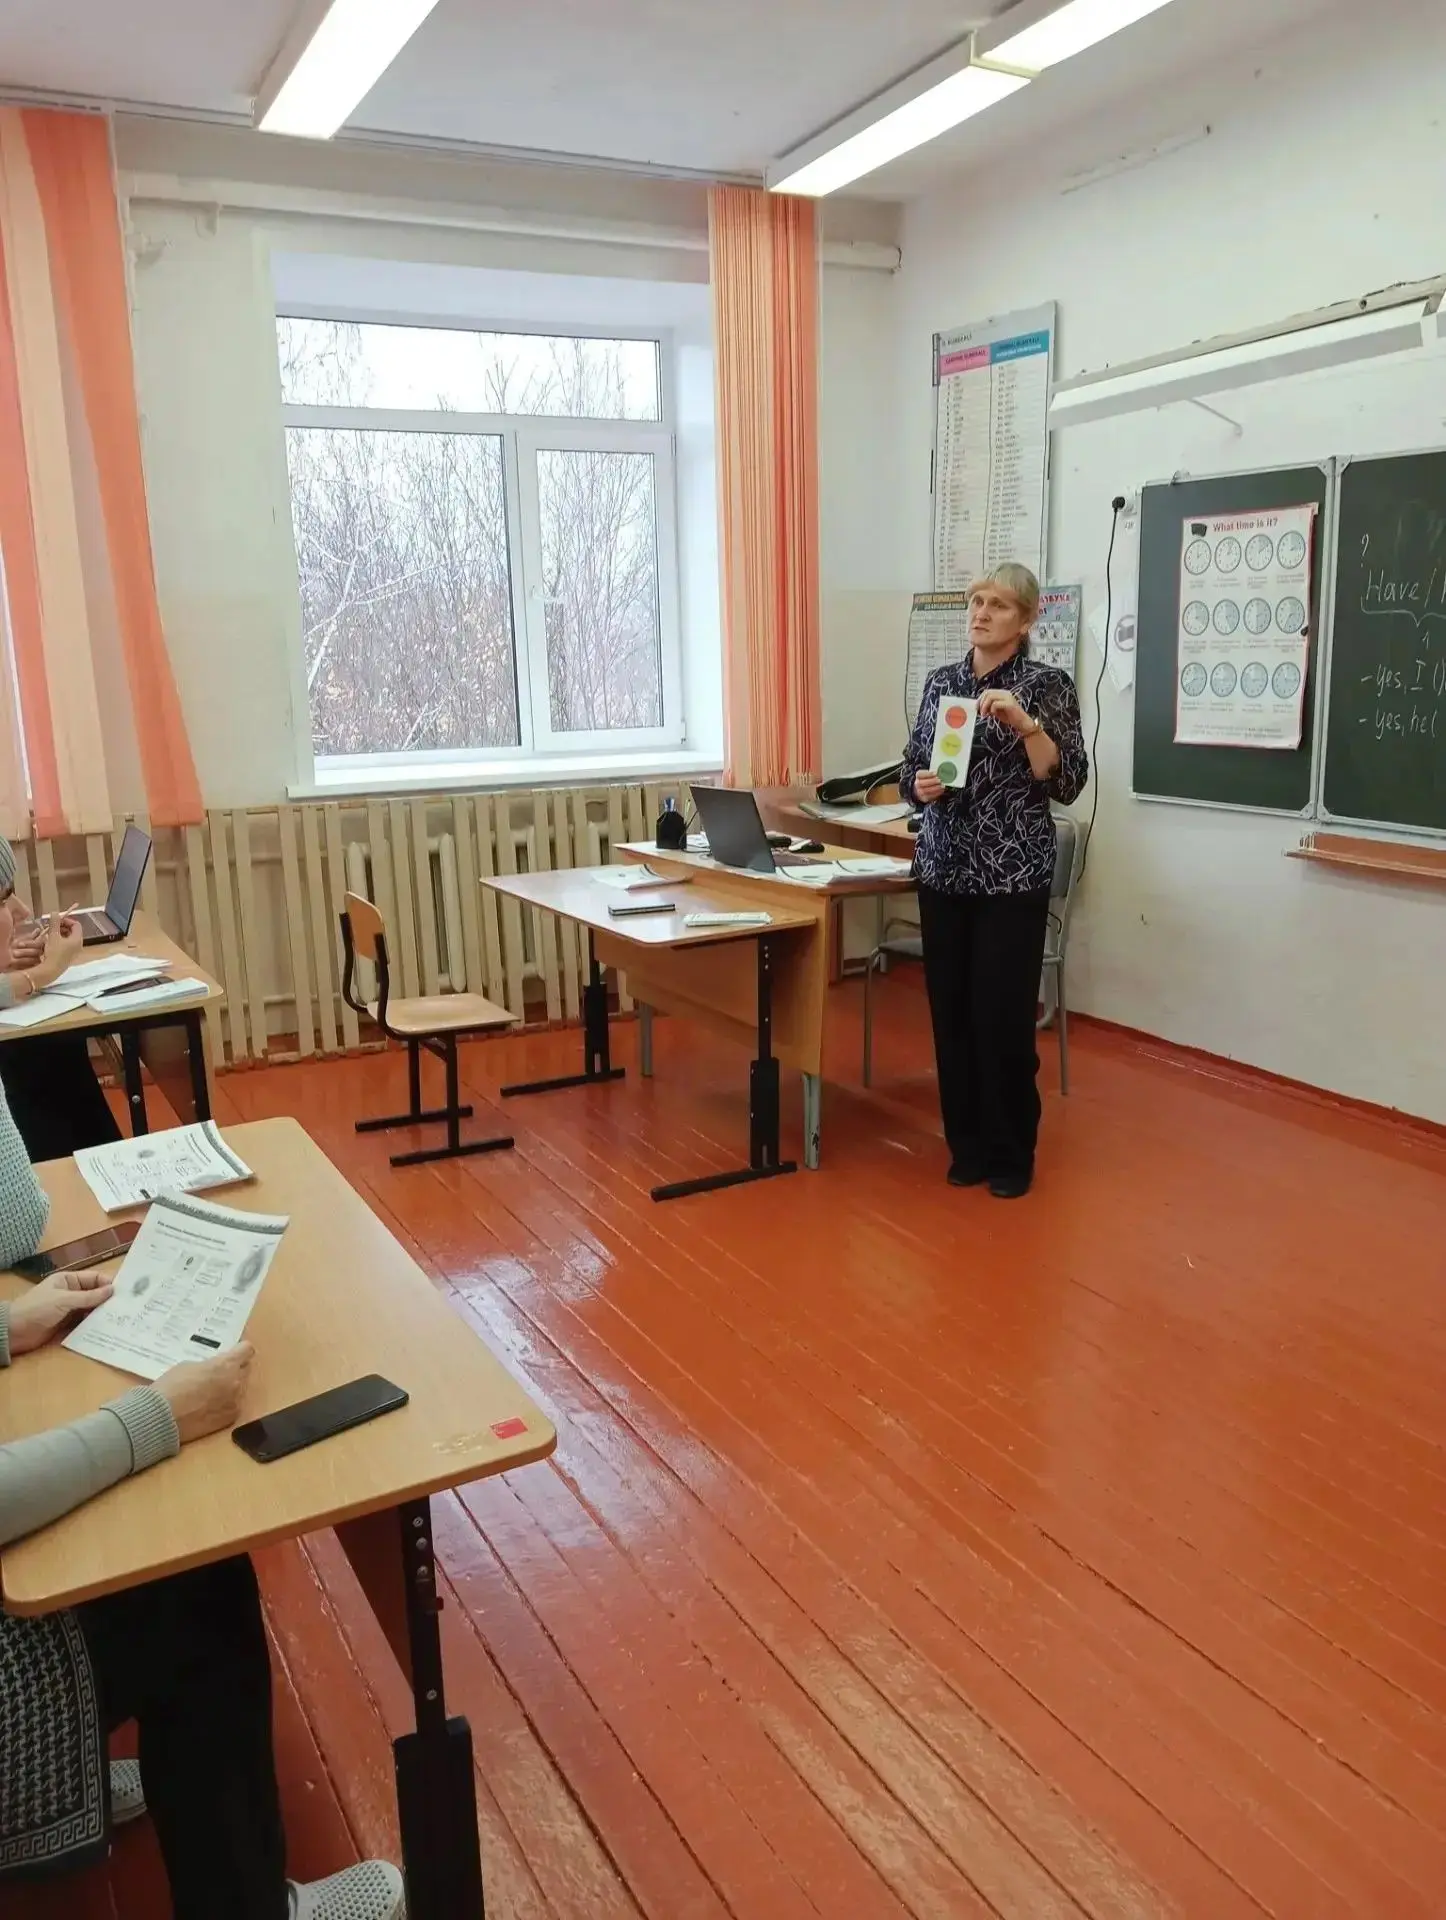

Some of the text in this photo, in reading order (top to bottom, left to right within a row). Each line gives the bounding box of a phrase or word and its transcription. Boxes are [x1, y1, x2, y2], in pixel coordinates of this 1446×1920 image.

[1213, 517, 1278, 532] What time is it?
[1365, 569, 1419, 602] Have
